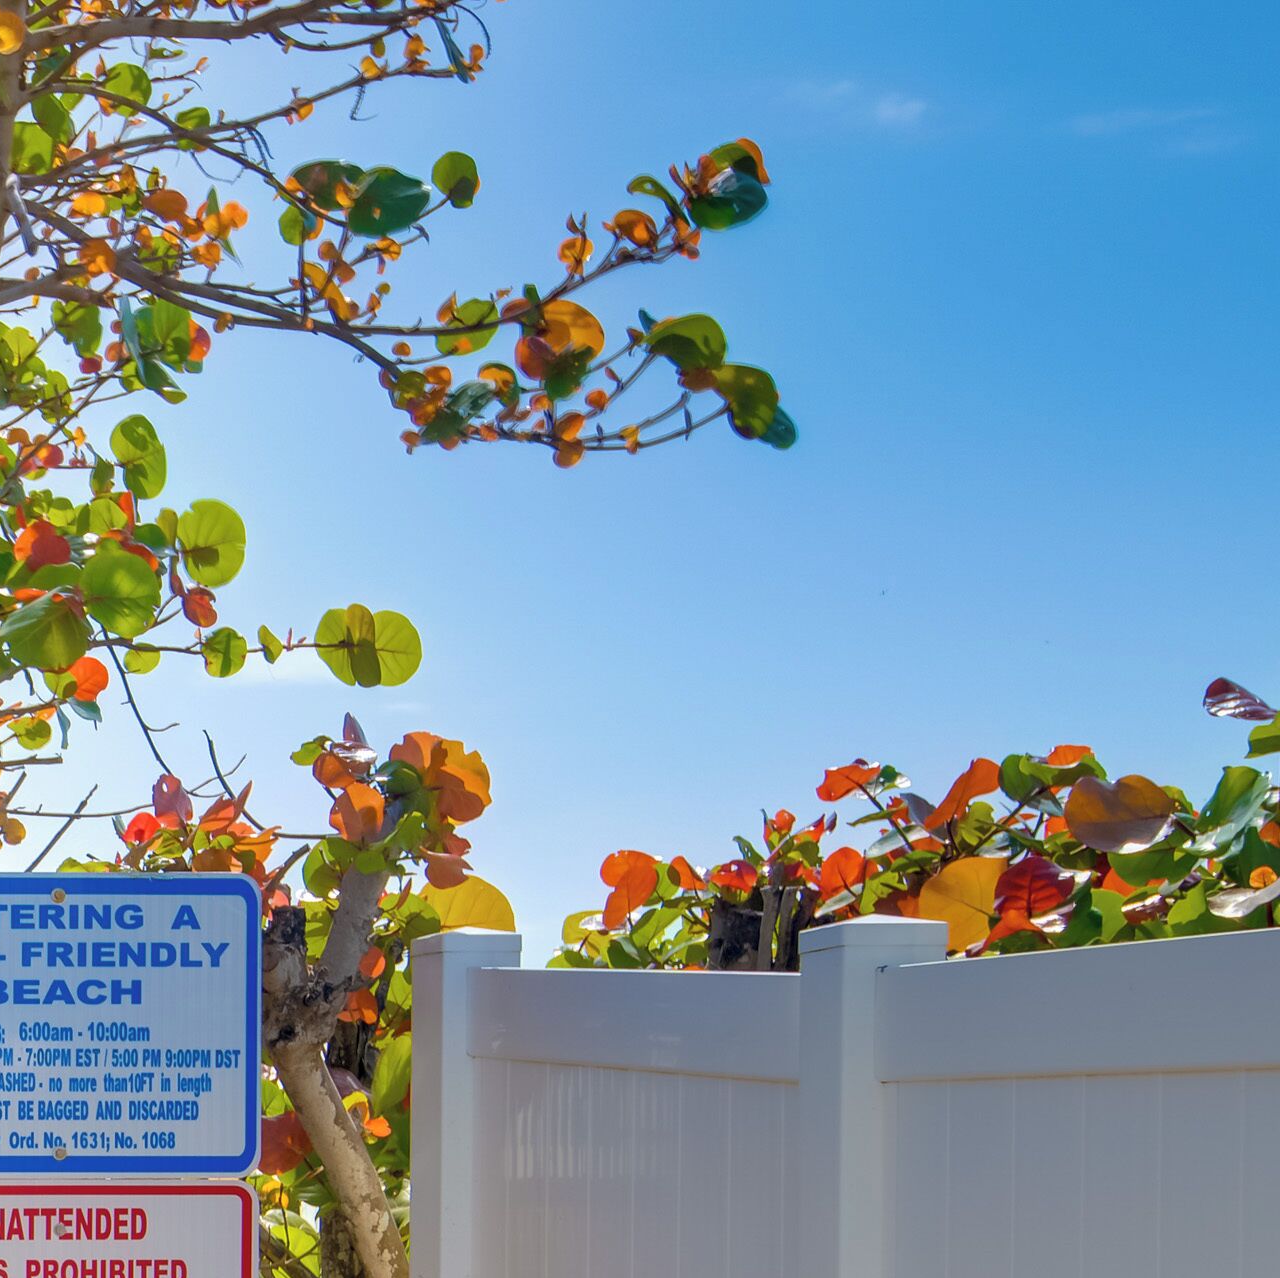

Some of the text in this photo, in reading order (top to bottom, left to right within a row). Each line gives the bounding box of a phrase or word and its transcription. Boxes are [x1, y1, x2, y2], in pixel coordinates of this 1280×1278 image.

[171, 904, 200, 929] A
[21, 941, 229, 967] FRIENDLY
[19, 1021, 72, 1041] 6:00am
[87, 1021, 149, 1041] 10:00am
[25, 1048, 70, 1066] 7:00PM
[75, 1048, 100, 1066] EST
[111, 1048, 138, 1067] 5:00
[142, 1048, 160, 1067] PM
[165, 1049, 210, 1068] 9:00PM
[215, 1049, 240, 1068] DST
[49, 1077, 62, 1092] no
[69, 1077, 96, 1091] more
[160, 1072, 170, 1091] in
[177, 1072, 211, 1097] length
[18, 1100, 33, 1120] BE
[38, 1100, 88, 1120] BAGGED
[95, 1100, 121, 1120] AND
[128, 1100, 198, 1120] DISCARDED
[9, 1131, 38, 1148] Ord.
[43, 1132, 66, 1148] No.
[114, 1132, 137, 1148] No.
[142, 1131, 175, 1149] 1068
